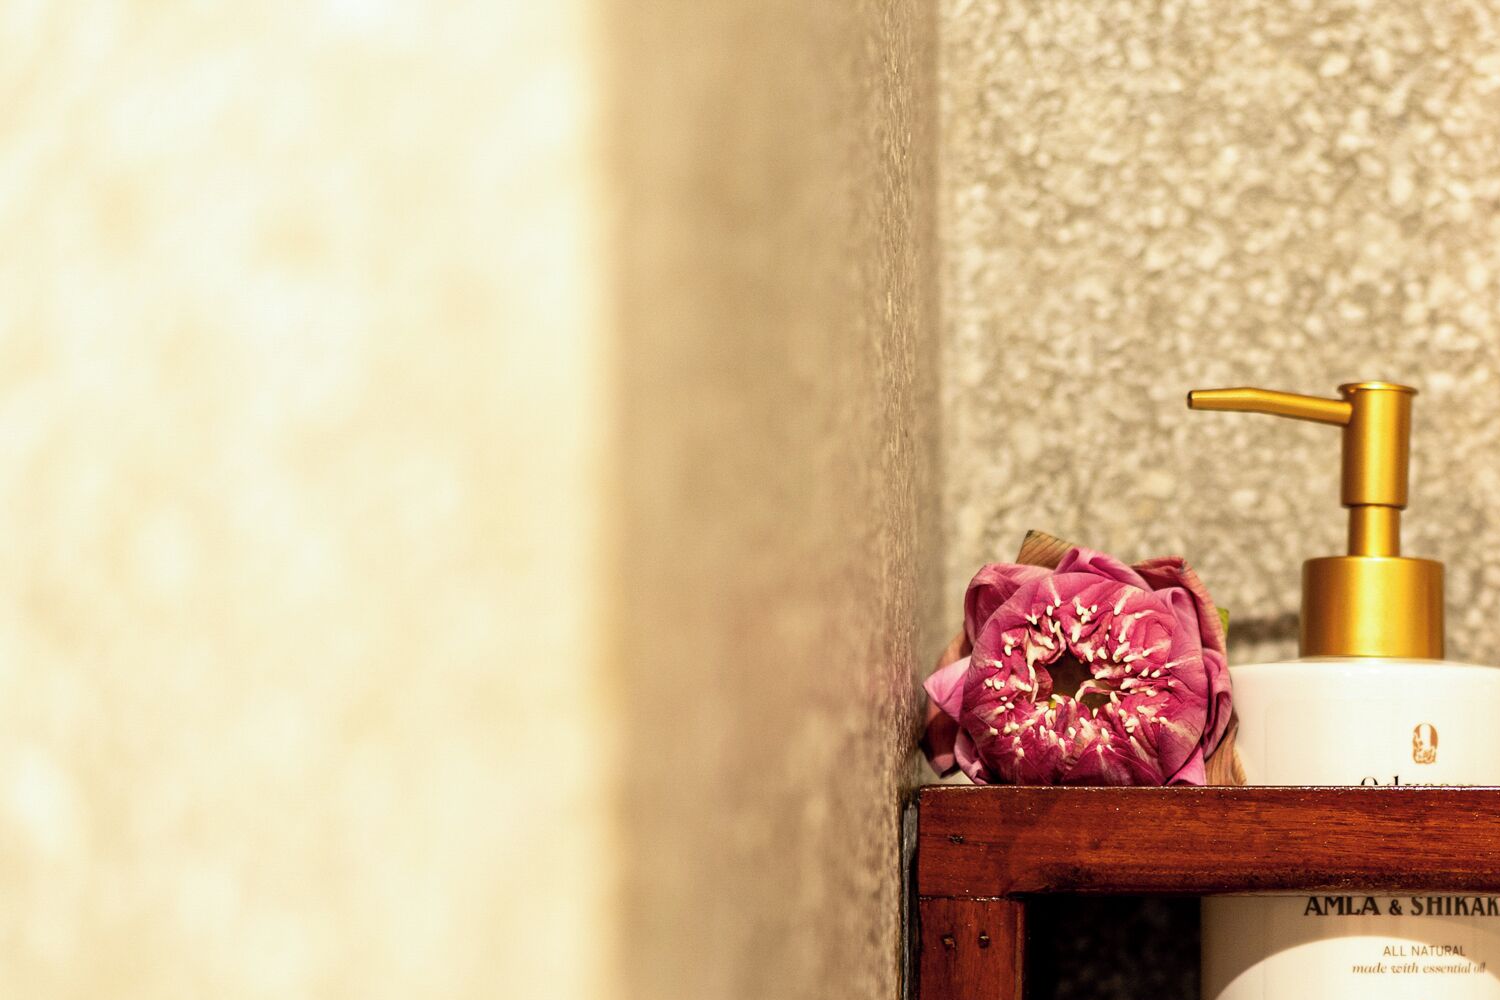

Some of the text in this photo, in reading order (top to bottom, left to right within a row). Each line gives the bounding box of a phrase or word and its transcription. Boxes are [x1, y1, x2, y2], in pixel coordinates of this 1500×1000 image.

[1303, 896, 1381, 916] AMLA
[1389, 899, 1403, 916] &
[1383, 945, 1466, 957] ALL NATURAL
[1352, 962, 1387, 974] made
[1390, 962, 1419, 974] with
[1422, 962, 1471, 974] essential
